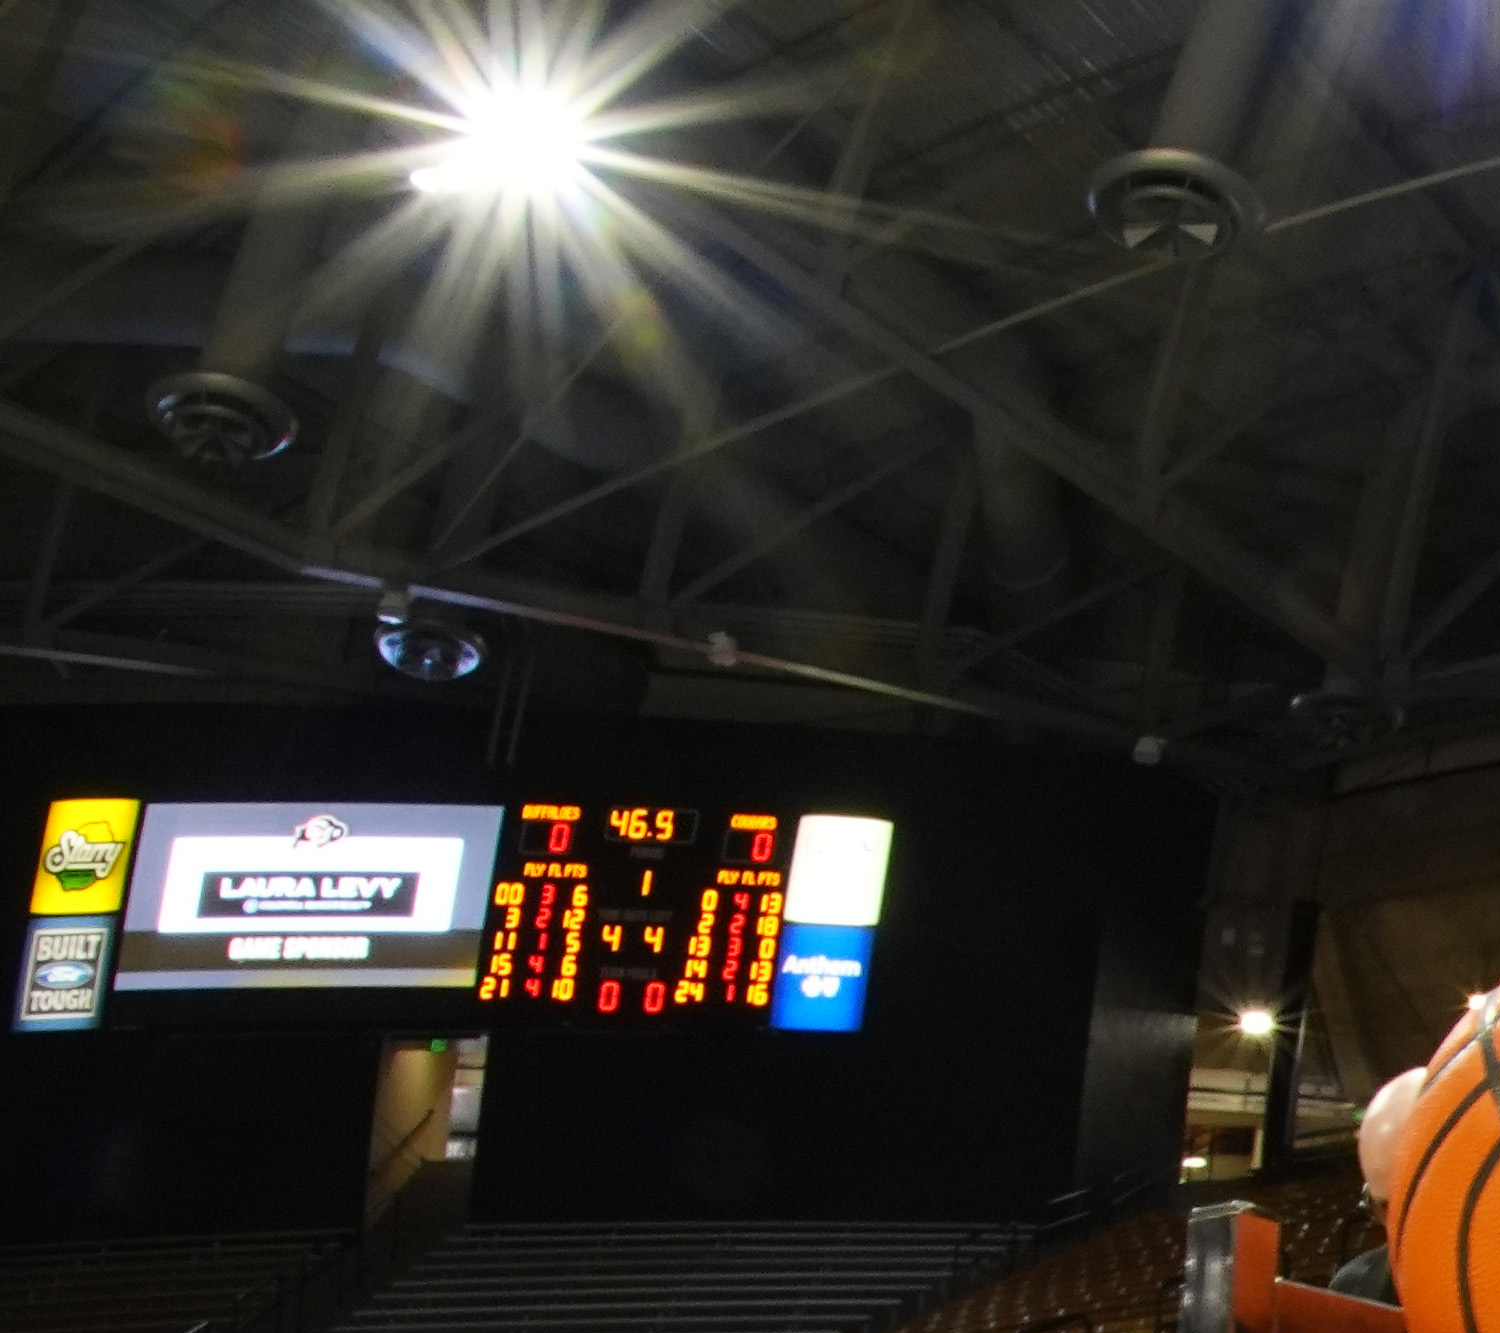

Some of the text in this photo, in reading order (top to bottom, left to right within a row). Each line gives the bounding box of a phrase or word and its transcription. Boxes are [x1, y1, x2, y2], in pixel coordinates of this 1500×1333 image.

[610, 809, 674, 840] 46.9
[548, 822, 570, 853] 0
[751, 830, 773, 862] 0
[219, 876, 402, 899] LAURA LEVY
[494, 883, 588, 907] 00 3 6
[641, 870, 652, 896] 1
[701, 889, 782, 914] 0 4 13
[505, 907, 521, 929] 3
[535, 908, 552, 929] 2
[563, 909, 585, 930] 12
[698, 913, 779, 936] 2 2 18
[36, 935, 102, 961] BUILT
[494, 931, 581, 953] 11 1 5
[601, 925, 664, 953] 4 4
[689, 936, 776, 960] 13 3 0
[490, 953, 512, 975] 15
[528, 955, 545, 974] 4
[561, 955, 577, 977] 6
[685, 960, 772, 982] 14 2 13
[782, 954, 862, 977] Anthem
[30, 989, 93, 1011] TOUGH
[479, 976, 575, 1001] 21 4 10
[598, 980, 666, 1013] 0 0
[674, 980, 768, 1006] 24 1 16
